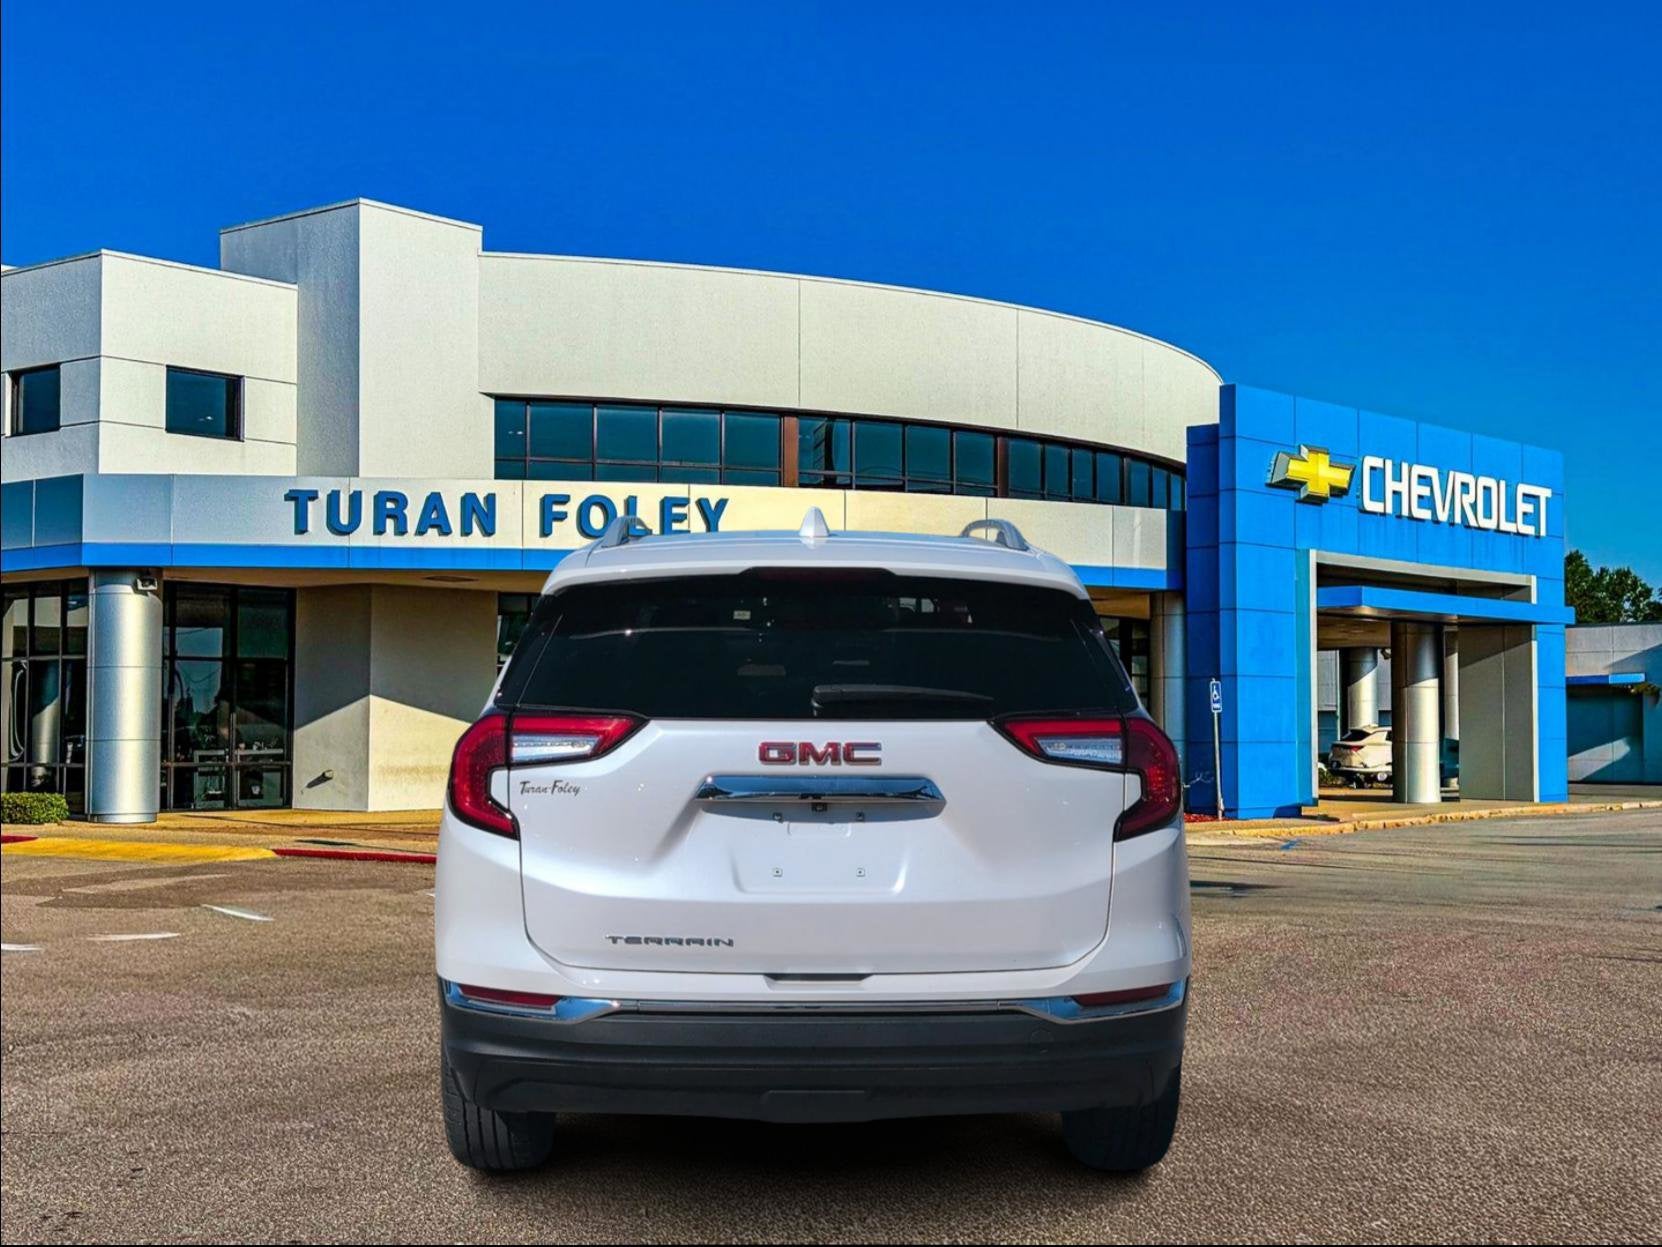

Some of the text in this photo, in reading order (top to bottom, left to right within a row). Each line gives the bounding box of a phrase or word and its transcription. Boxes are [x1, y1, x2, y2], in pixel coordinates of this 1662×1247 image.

[284, 489, 729, 538] TURAN FOLEY
[1362, 455, 1552, 537] CHEVROLET
[759, 742, 882, 766] GMC
[605, 936, 734, 947] TERRAIN
